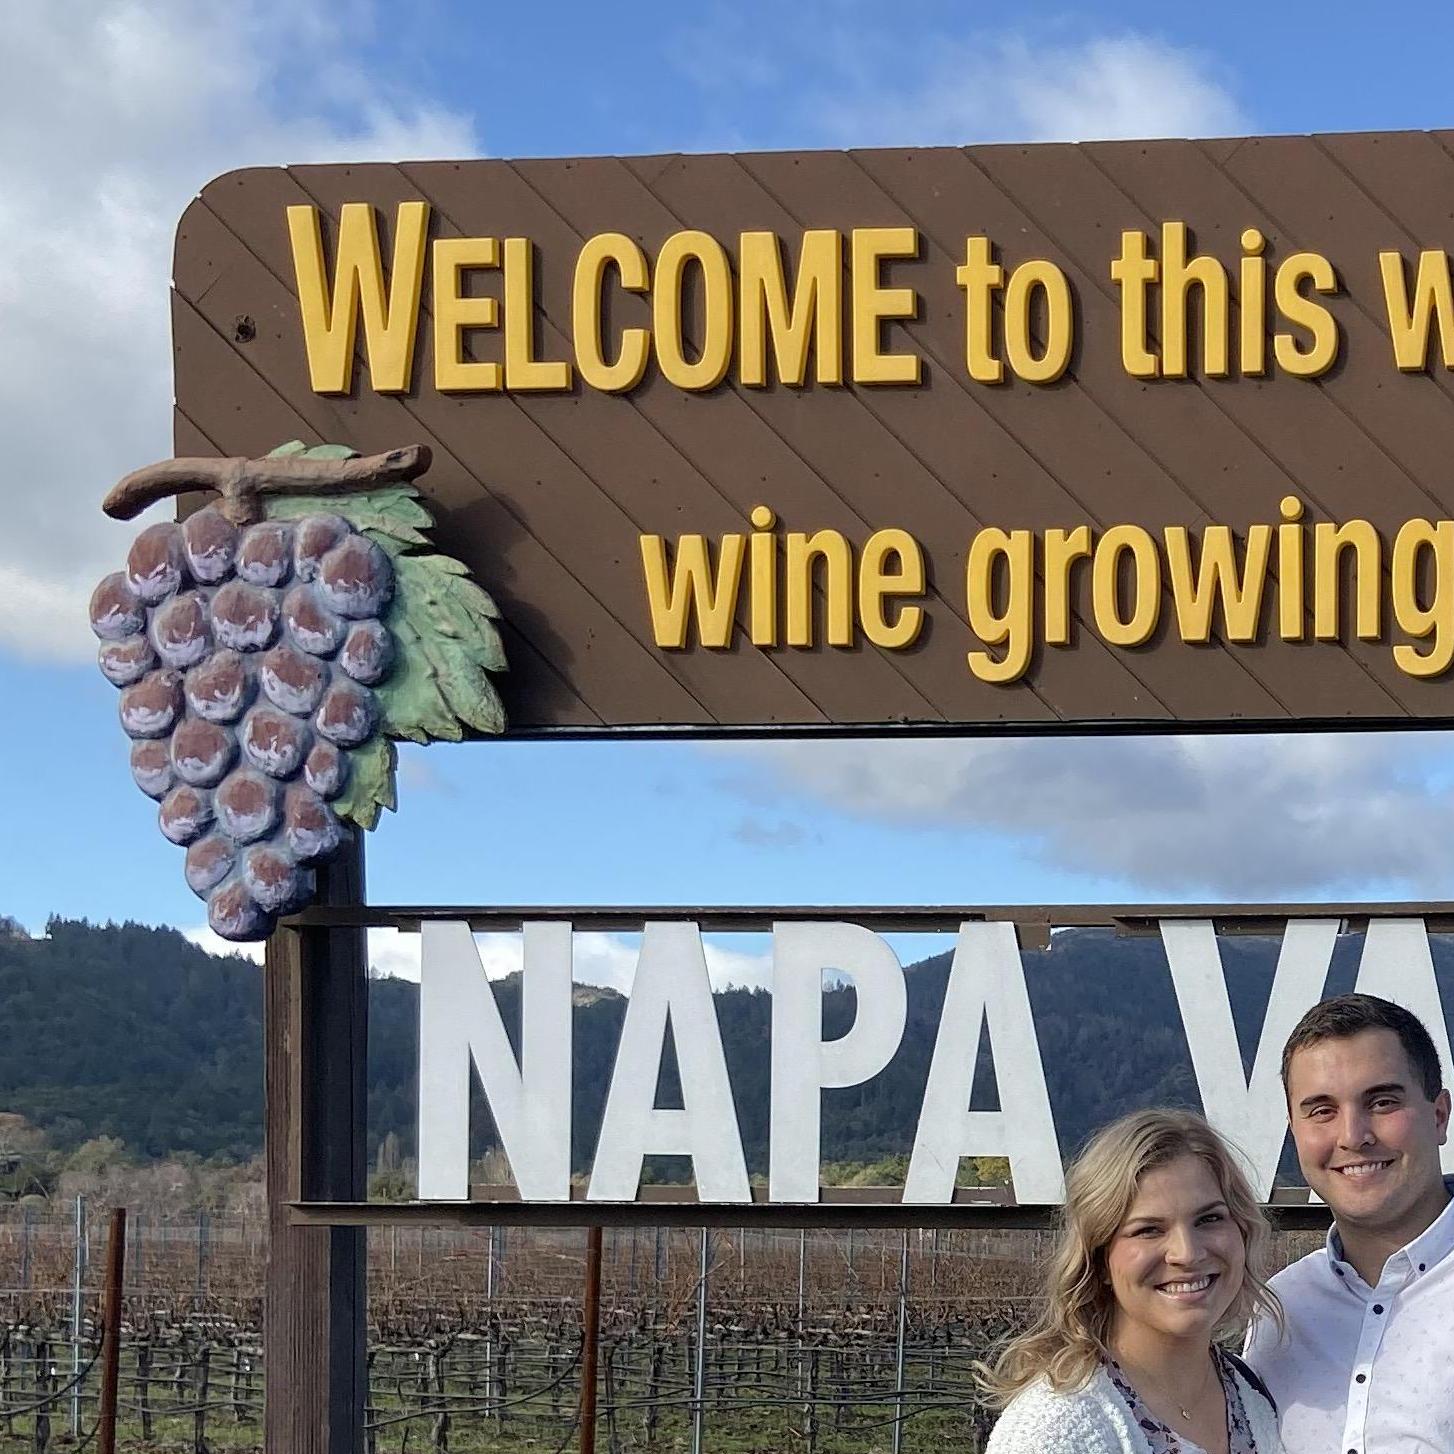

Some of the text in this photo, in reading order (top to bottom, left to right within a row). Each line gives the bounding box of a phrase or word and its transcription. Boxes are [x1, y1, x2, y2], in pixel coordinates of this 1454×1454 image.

[286, 201, 924, 396] WELCOME
[956, 235, 1073, 386] to
[1110, 220, 1338, 380] this
[639, 504, 925, 650] wine
[417, 919, 1063, 1205] NAPA
